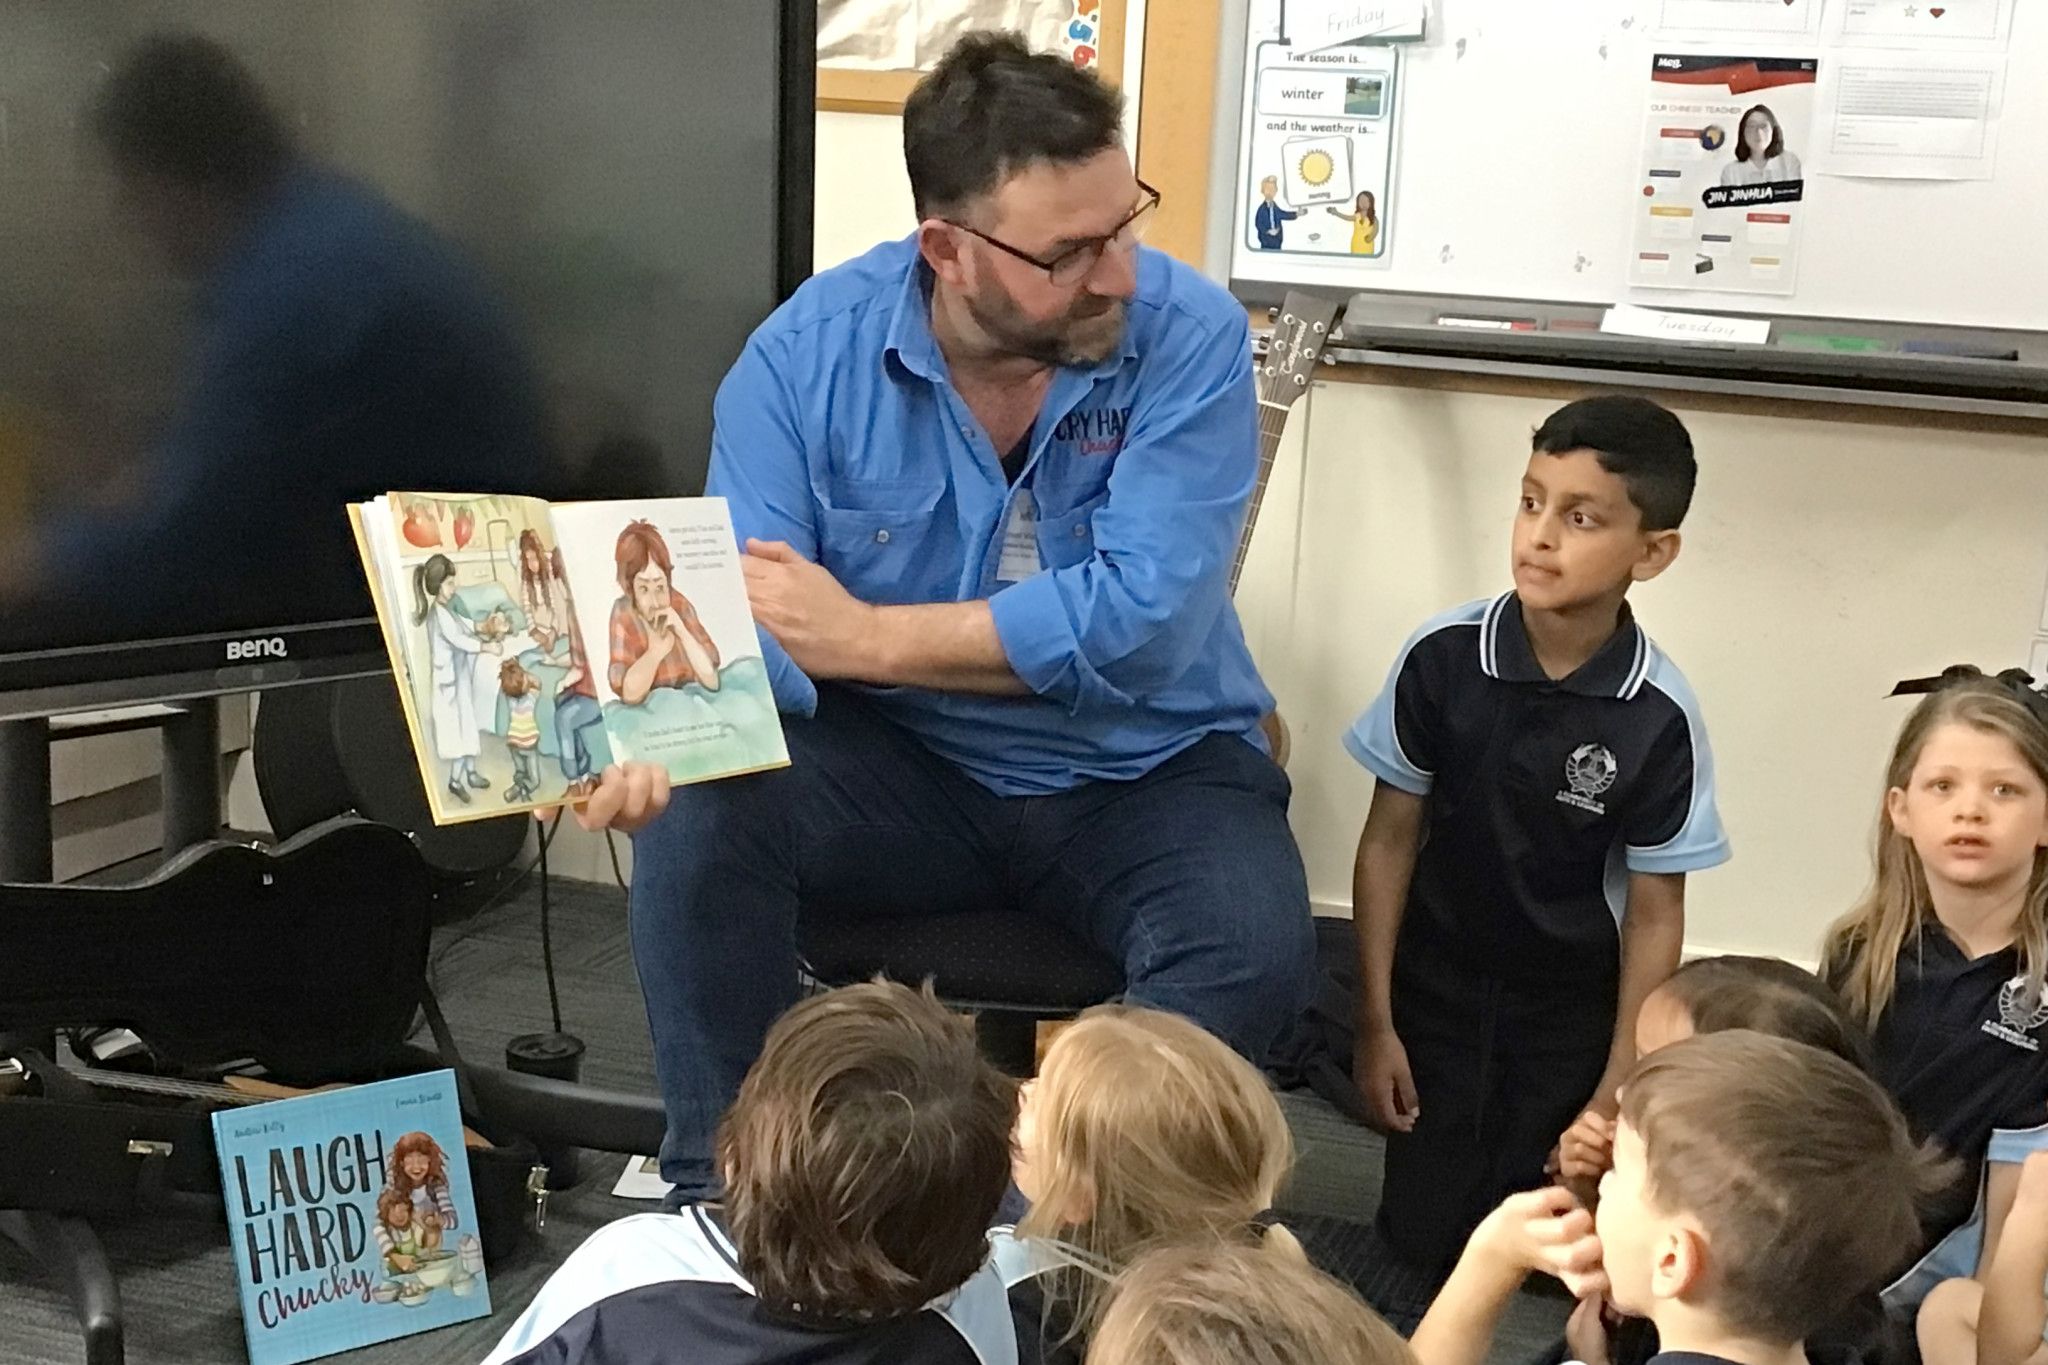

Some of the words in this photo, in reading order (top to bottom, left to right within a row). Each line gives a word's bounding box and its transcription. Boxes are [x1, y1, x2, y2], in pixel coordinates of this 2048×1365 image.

[1328, 6, 1385, 34] Friday
[1309, 54, 1345, 64] season
[1281, 87, 1324, 100] winter
[1651, 103, 1667, 112] OUR
[1669, 103, 1702, 113] CHINESE
[1705, 105, 1742, 114] TEACHER
[1266, 120, 1287, 131] and
[1291, 121, 1307, 132] the
[1311, 122, 1354, 133] weather
[1708, 191, 1728, 204] JIN
[1730, 187, 1773, 201] JINHUA
[1658, 314, 1735, 337] Tuesday
[1055, 410, 1092, 441] CRY
[1097, 407, 1134, 437] HAR
[226, 637, 288, 660] BenQ
[234, 1129, 387, 1218] LAUGH
[244, 1202, 366, 1284] HARD
[257, 1262, 375, 1329] Chucky
